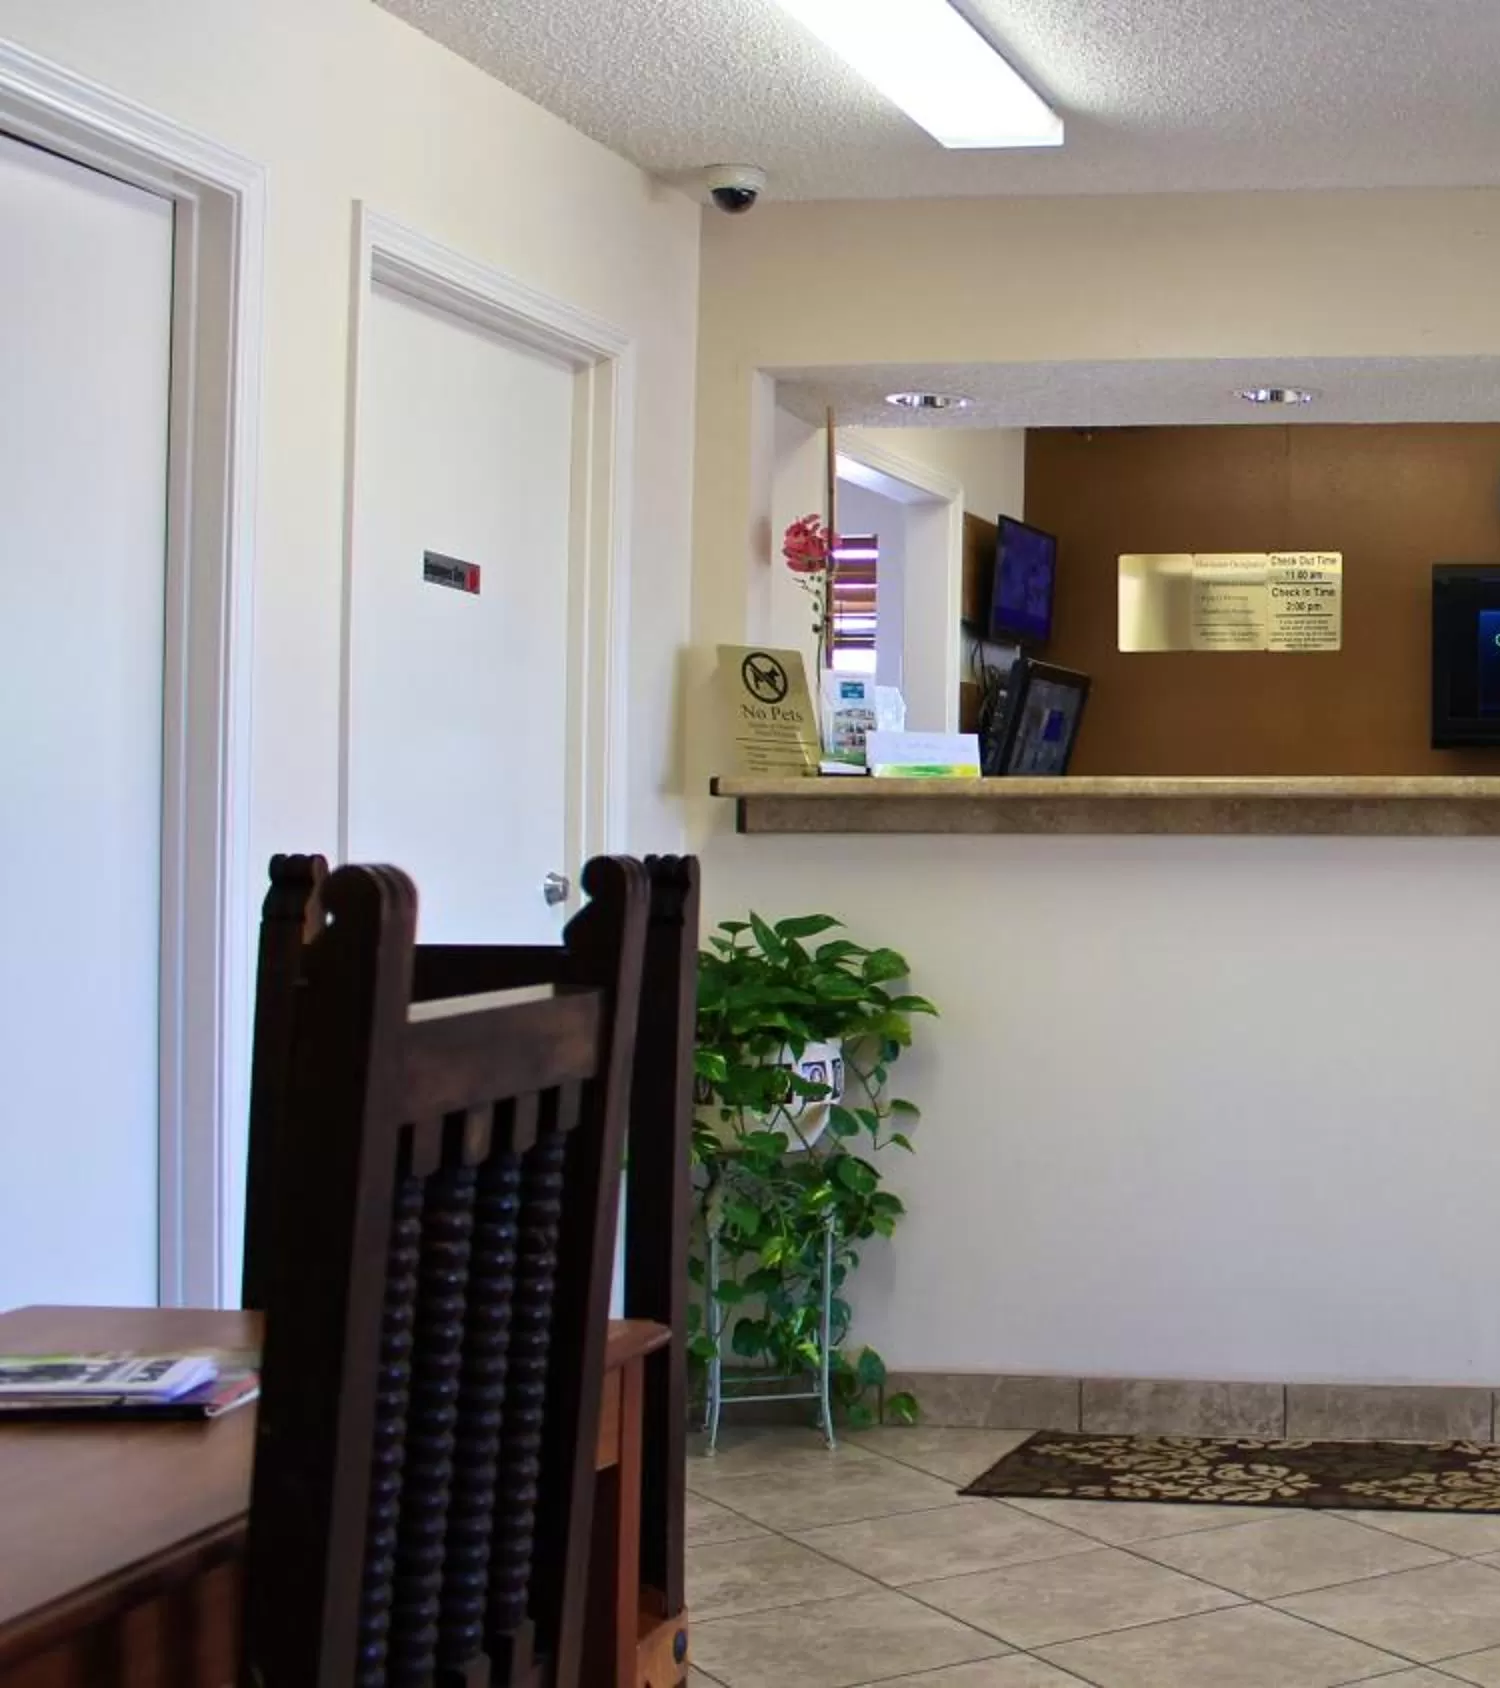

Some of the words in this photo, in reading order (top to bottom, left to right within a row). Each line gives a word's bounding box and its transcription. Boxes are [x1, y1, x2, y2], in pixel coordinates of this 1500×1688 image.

[1271, 555, 1297, 566] Check
[1299, 555, 1315, 566] Out
[1317, 555, 1337, 565] Time
[1271, 587, 1300, 597] Check
[1313, 587, 1336, 597] Time
[1307, 603, 1323, 614] pm
[739, 703, 767, 721] No
[771, 705, 805, 723] Pets
